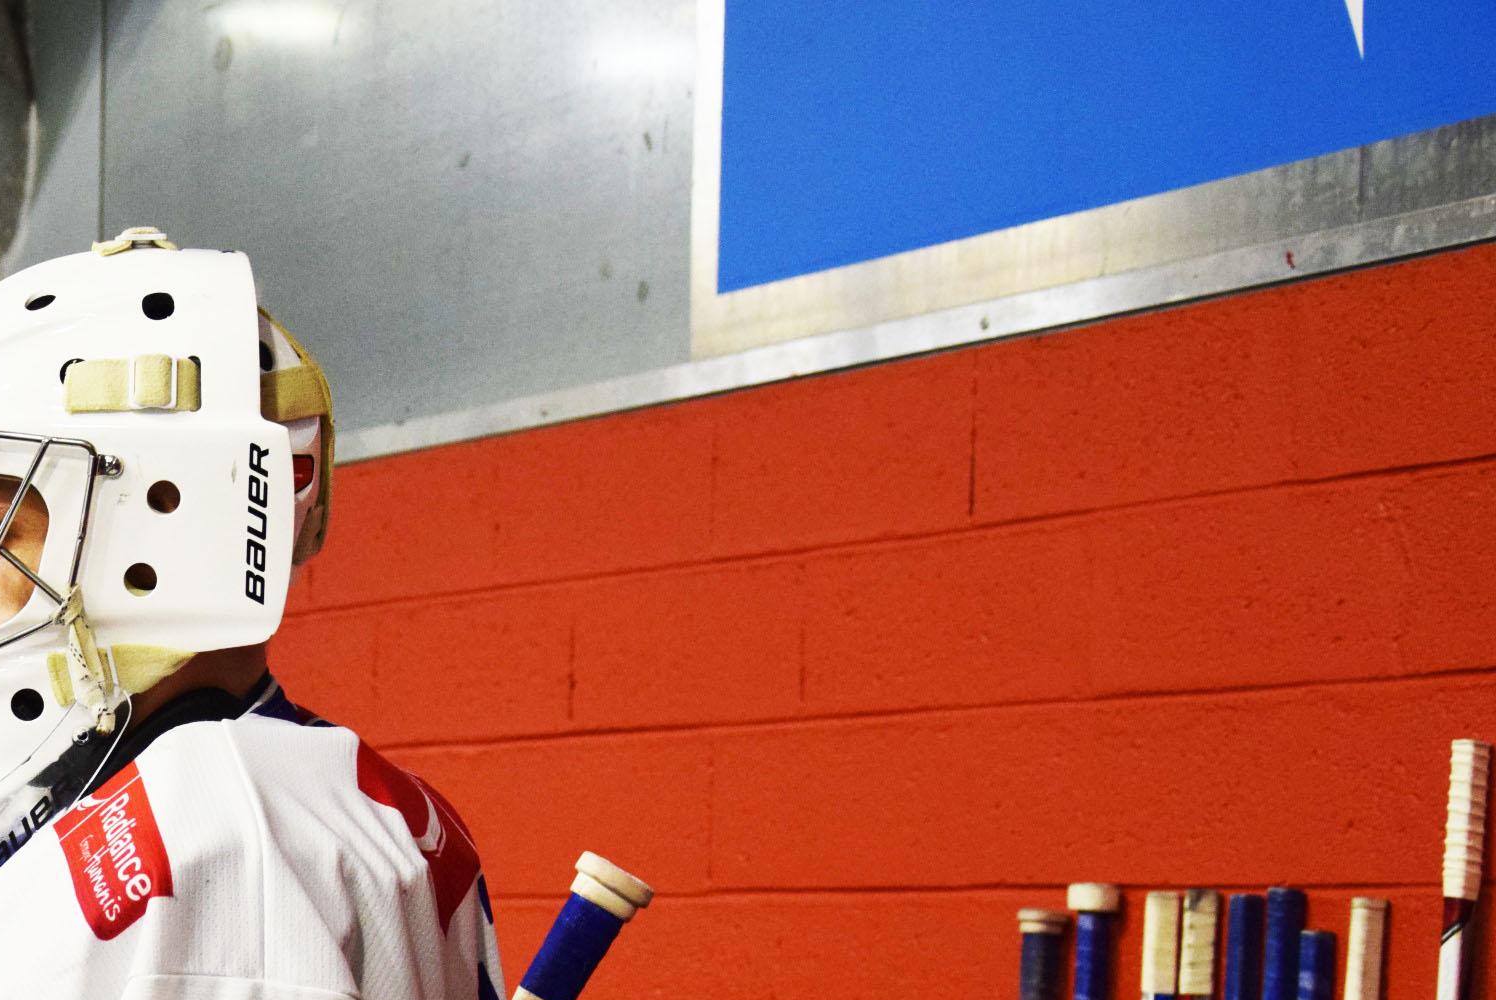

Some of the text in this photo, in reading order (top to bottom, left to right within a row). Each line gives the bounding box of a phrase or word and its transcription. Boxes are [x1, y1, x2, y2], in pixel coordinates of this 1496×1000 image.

[245, 442, 271, 605] BAUER
[83, 845, 121, 922] Humanis
[99, 792, 152, 902] Radiance
